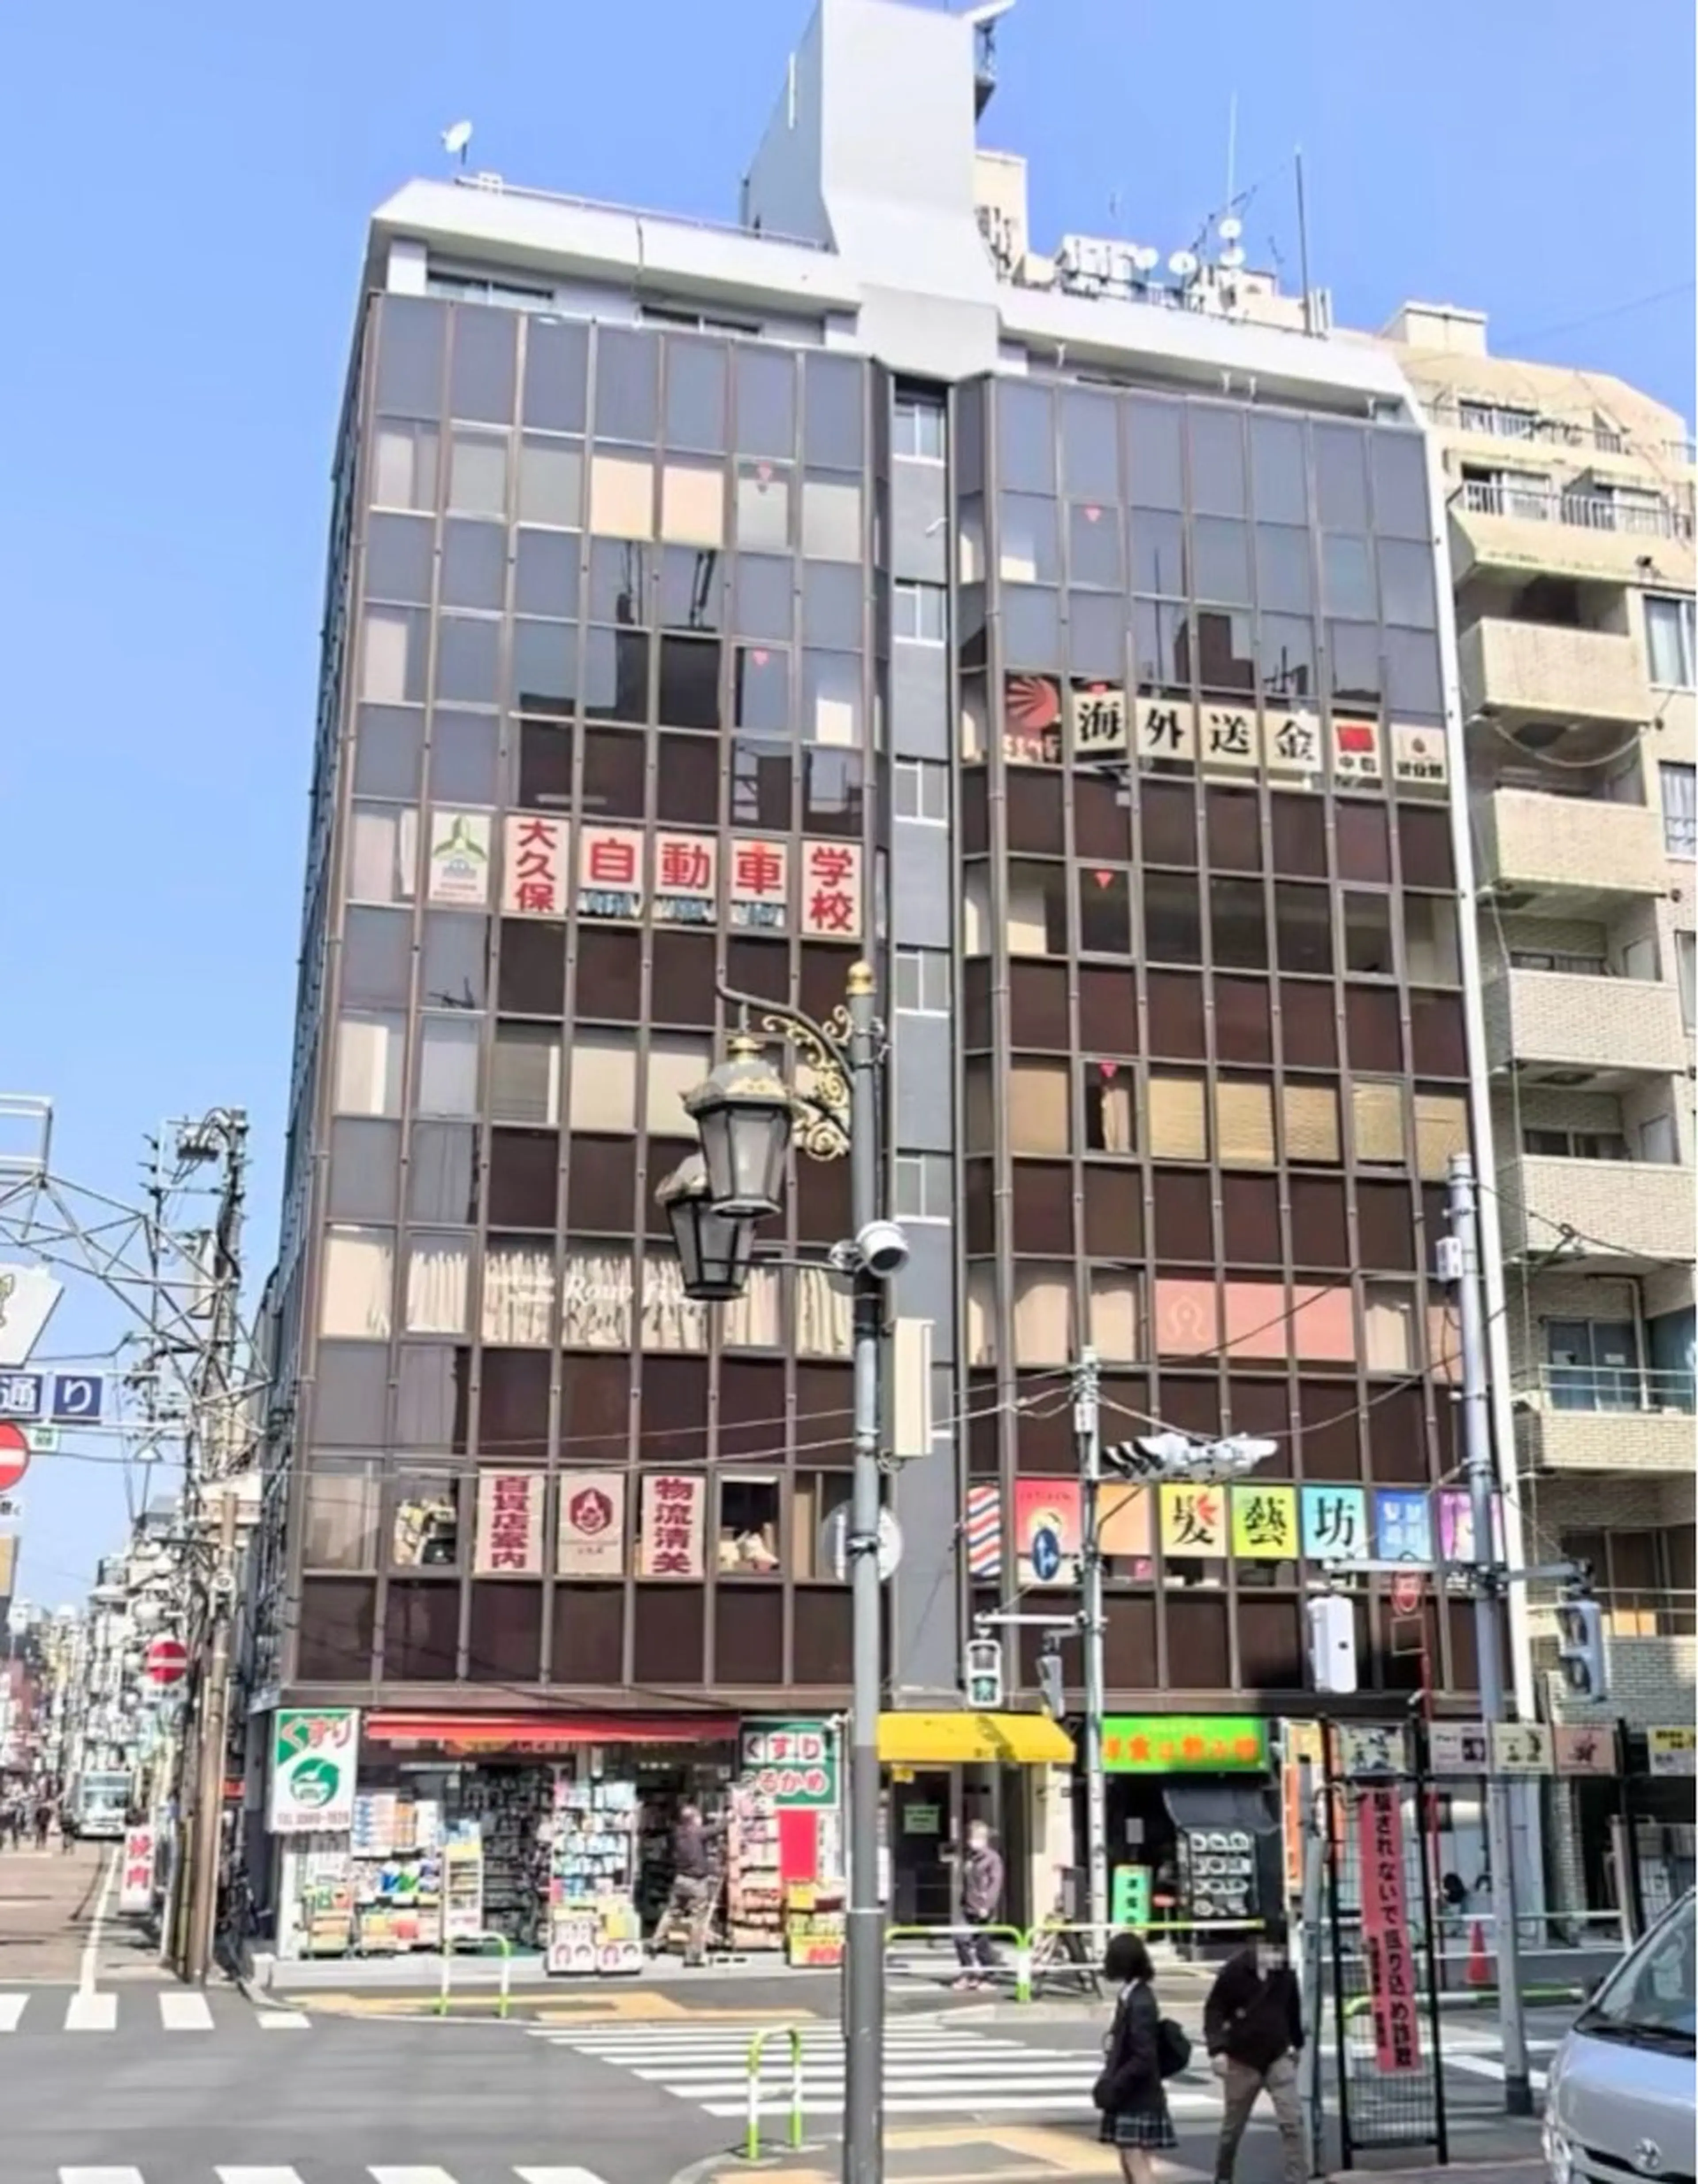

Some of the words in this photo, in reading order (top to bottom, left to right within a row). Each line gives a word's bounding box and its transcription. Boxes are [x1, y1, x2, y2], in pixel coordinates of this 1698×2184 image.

[1078, 701, 1315, 762] 海外送金
[516, 821, 557, 912] 大久保
[590, 838, 783, 894] 自動車
[810, 846, 854, 932] 学校
[0, 1376, 92, 1413] 通り
[282, 1715, 353, 1749] くすり
[746, 1735, 821, 1760] くすり
